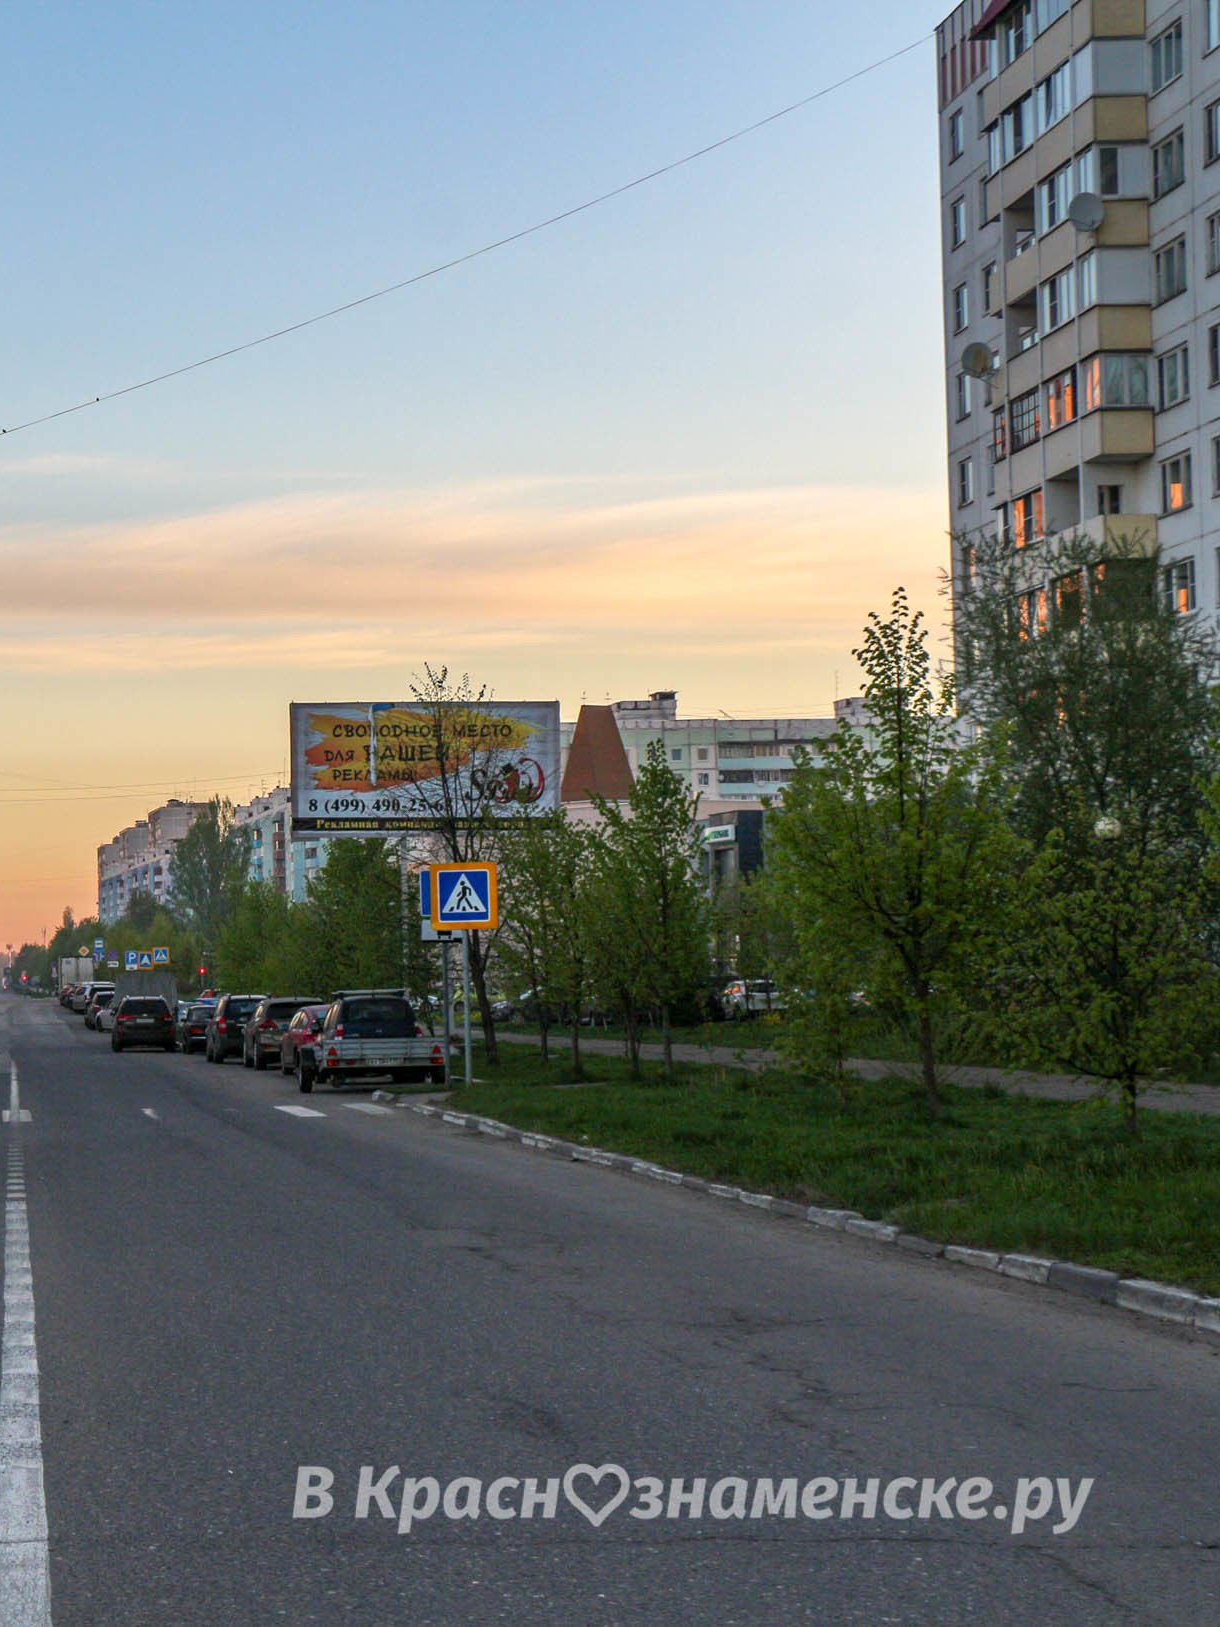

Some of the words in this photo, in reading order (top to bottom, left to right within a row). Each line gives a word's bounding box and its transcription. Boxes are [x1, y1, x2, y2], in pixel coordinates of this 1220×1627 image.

[452, 724, 512, 738] МЕСТО
[308, 799, 318, 812] 8
[324, 799, 366, 815] (499)
[316, 819, 379, 829] Рекламная
